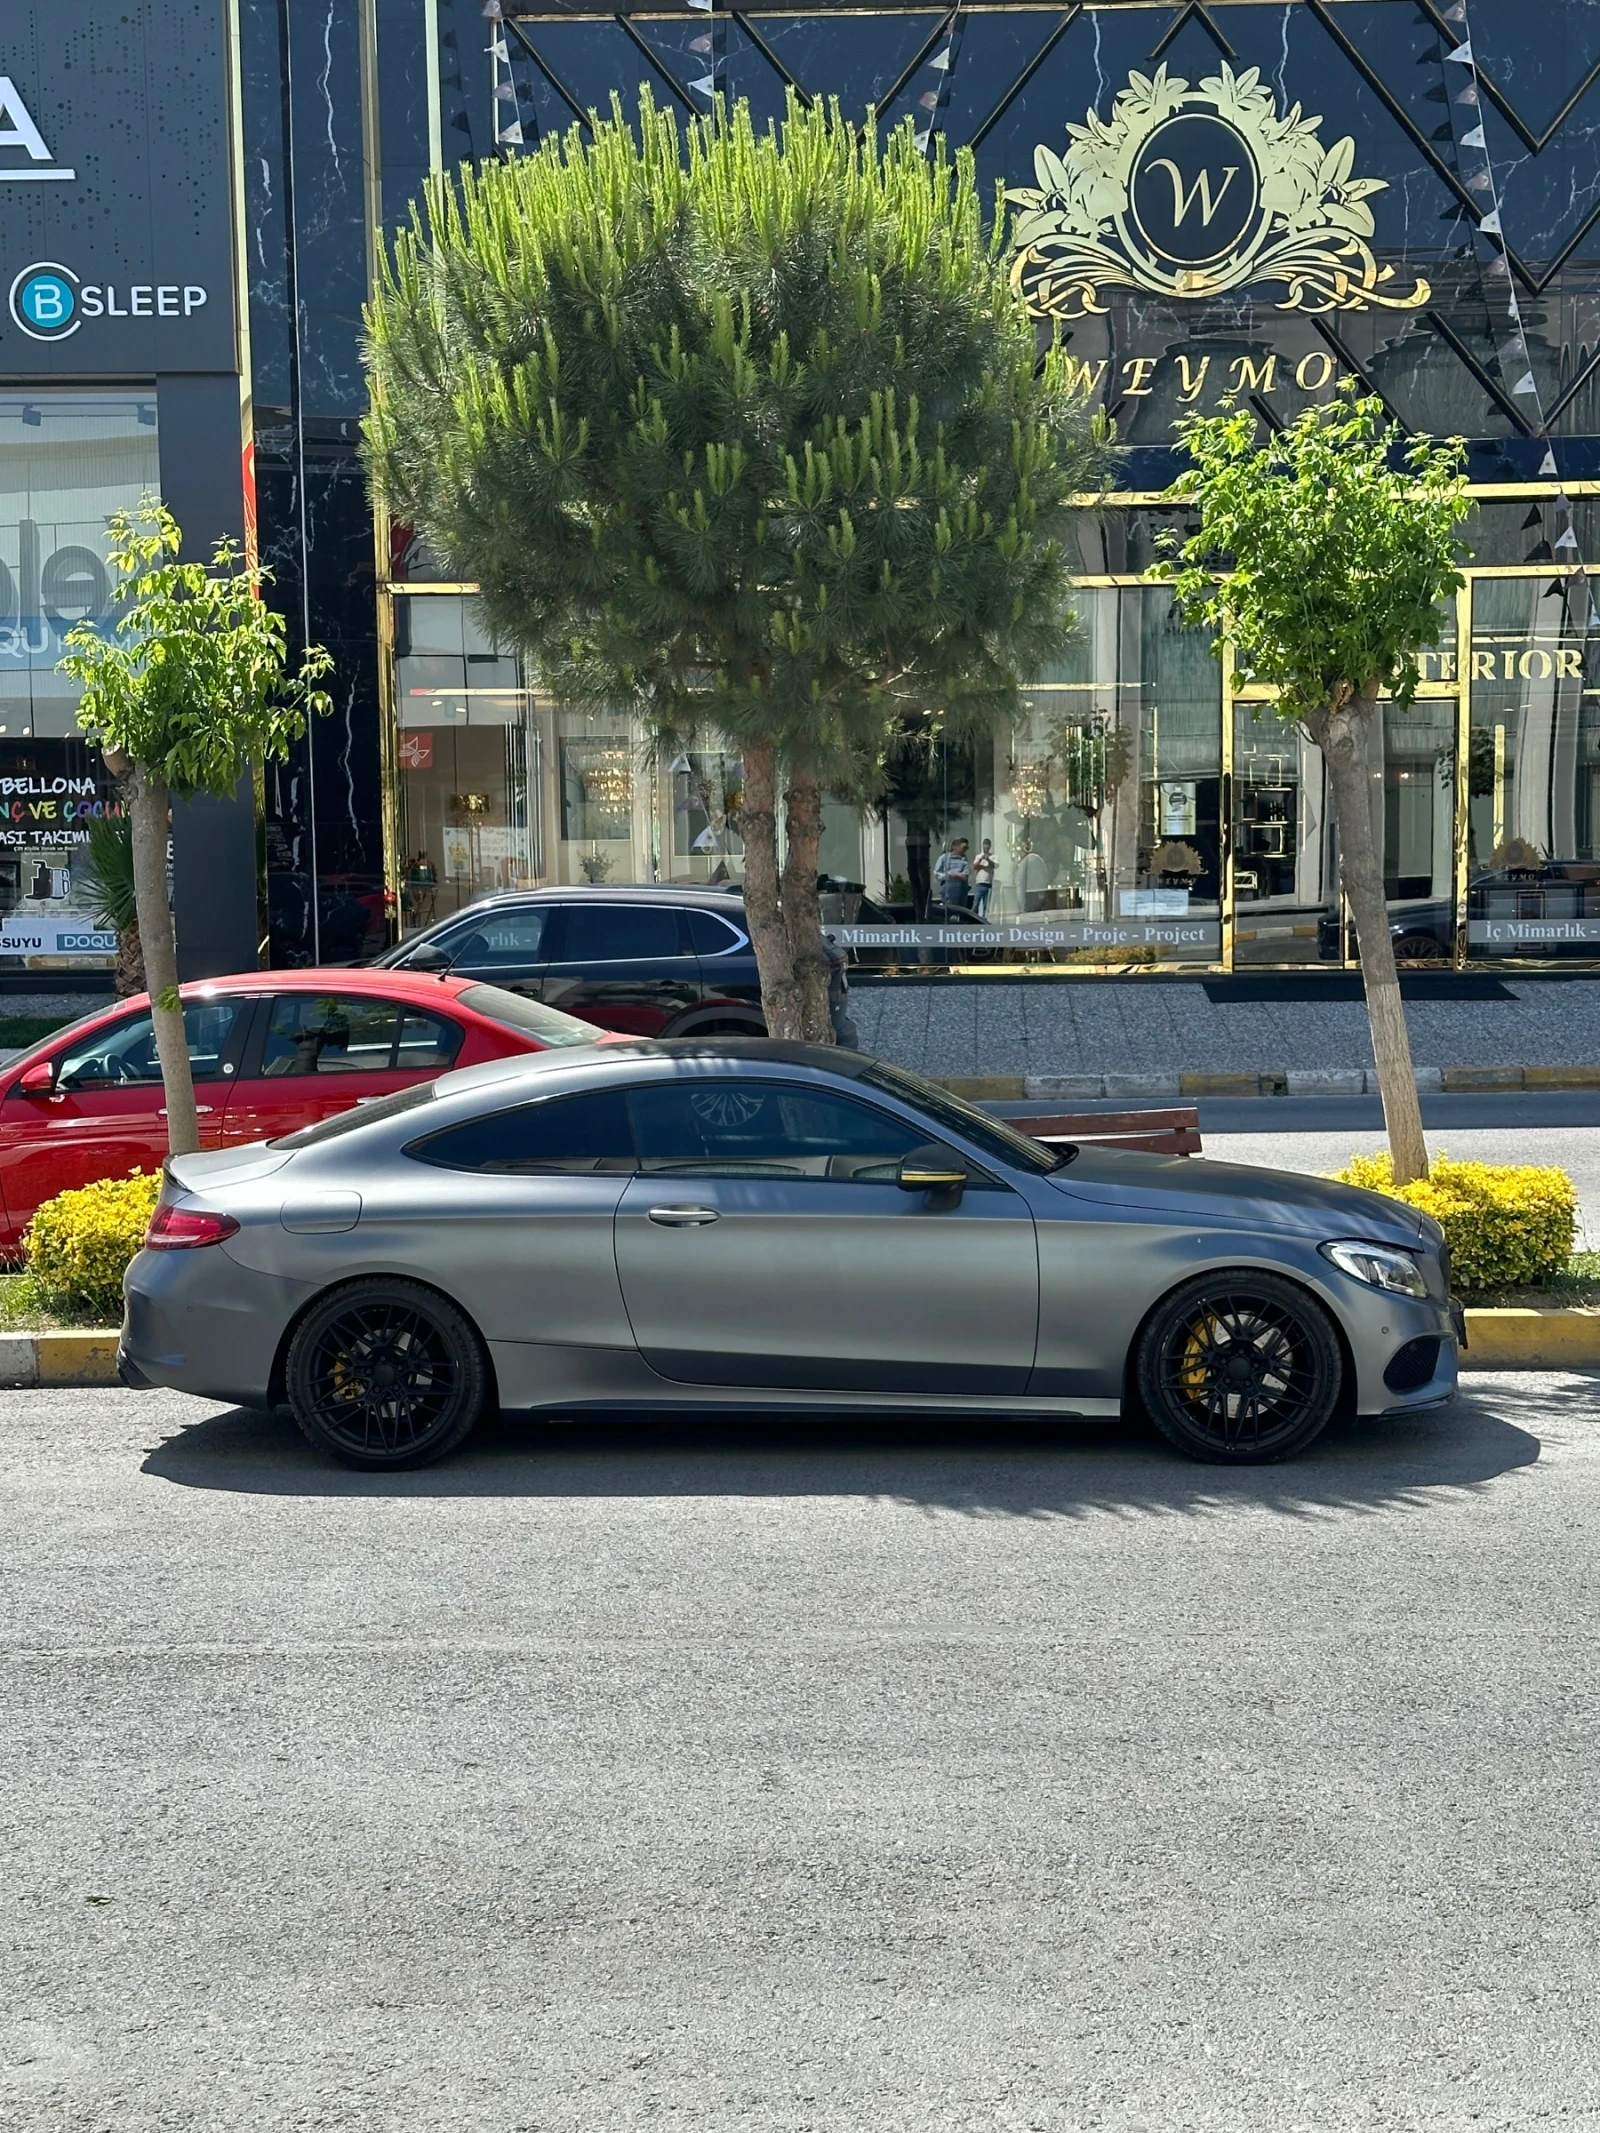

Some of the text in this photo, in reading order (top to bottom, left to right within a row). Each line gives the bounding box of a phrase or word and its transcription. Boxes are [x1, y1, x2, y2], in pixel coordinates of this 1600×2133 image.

[1144, 158, 1240, 227] W
[81, 285, 208, 316] SLEEP
[1061, 351, 1333, 402] WEYMO
[0, 777, 96, 796] BELLONA
[28, 800, 57, 820] VE
[841, 929, 922, 943] Mimarlık
[938, 927, 1004, 943] Interior
[1008, 927, 1065, 945] Design
[1082, 927, 1128, 945] Proje
[1144, 926, 1206, 945] Project
[1485, 921, 1502, 942] İç
[1506, 923, 1587, 938] Mimarlık
[64, 935, 117, 949] DOQU
